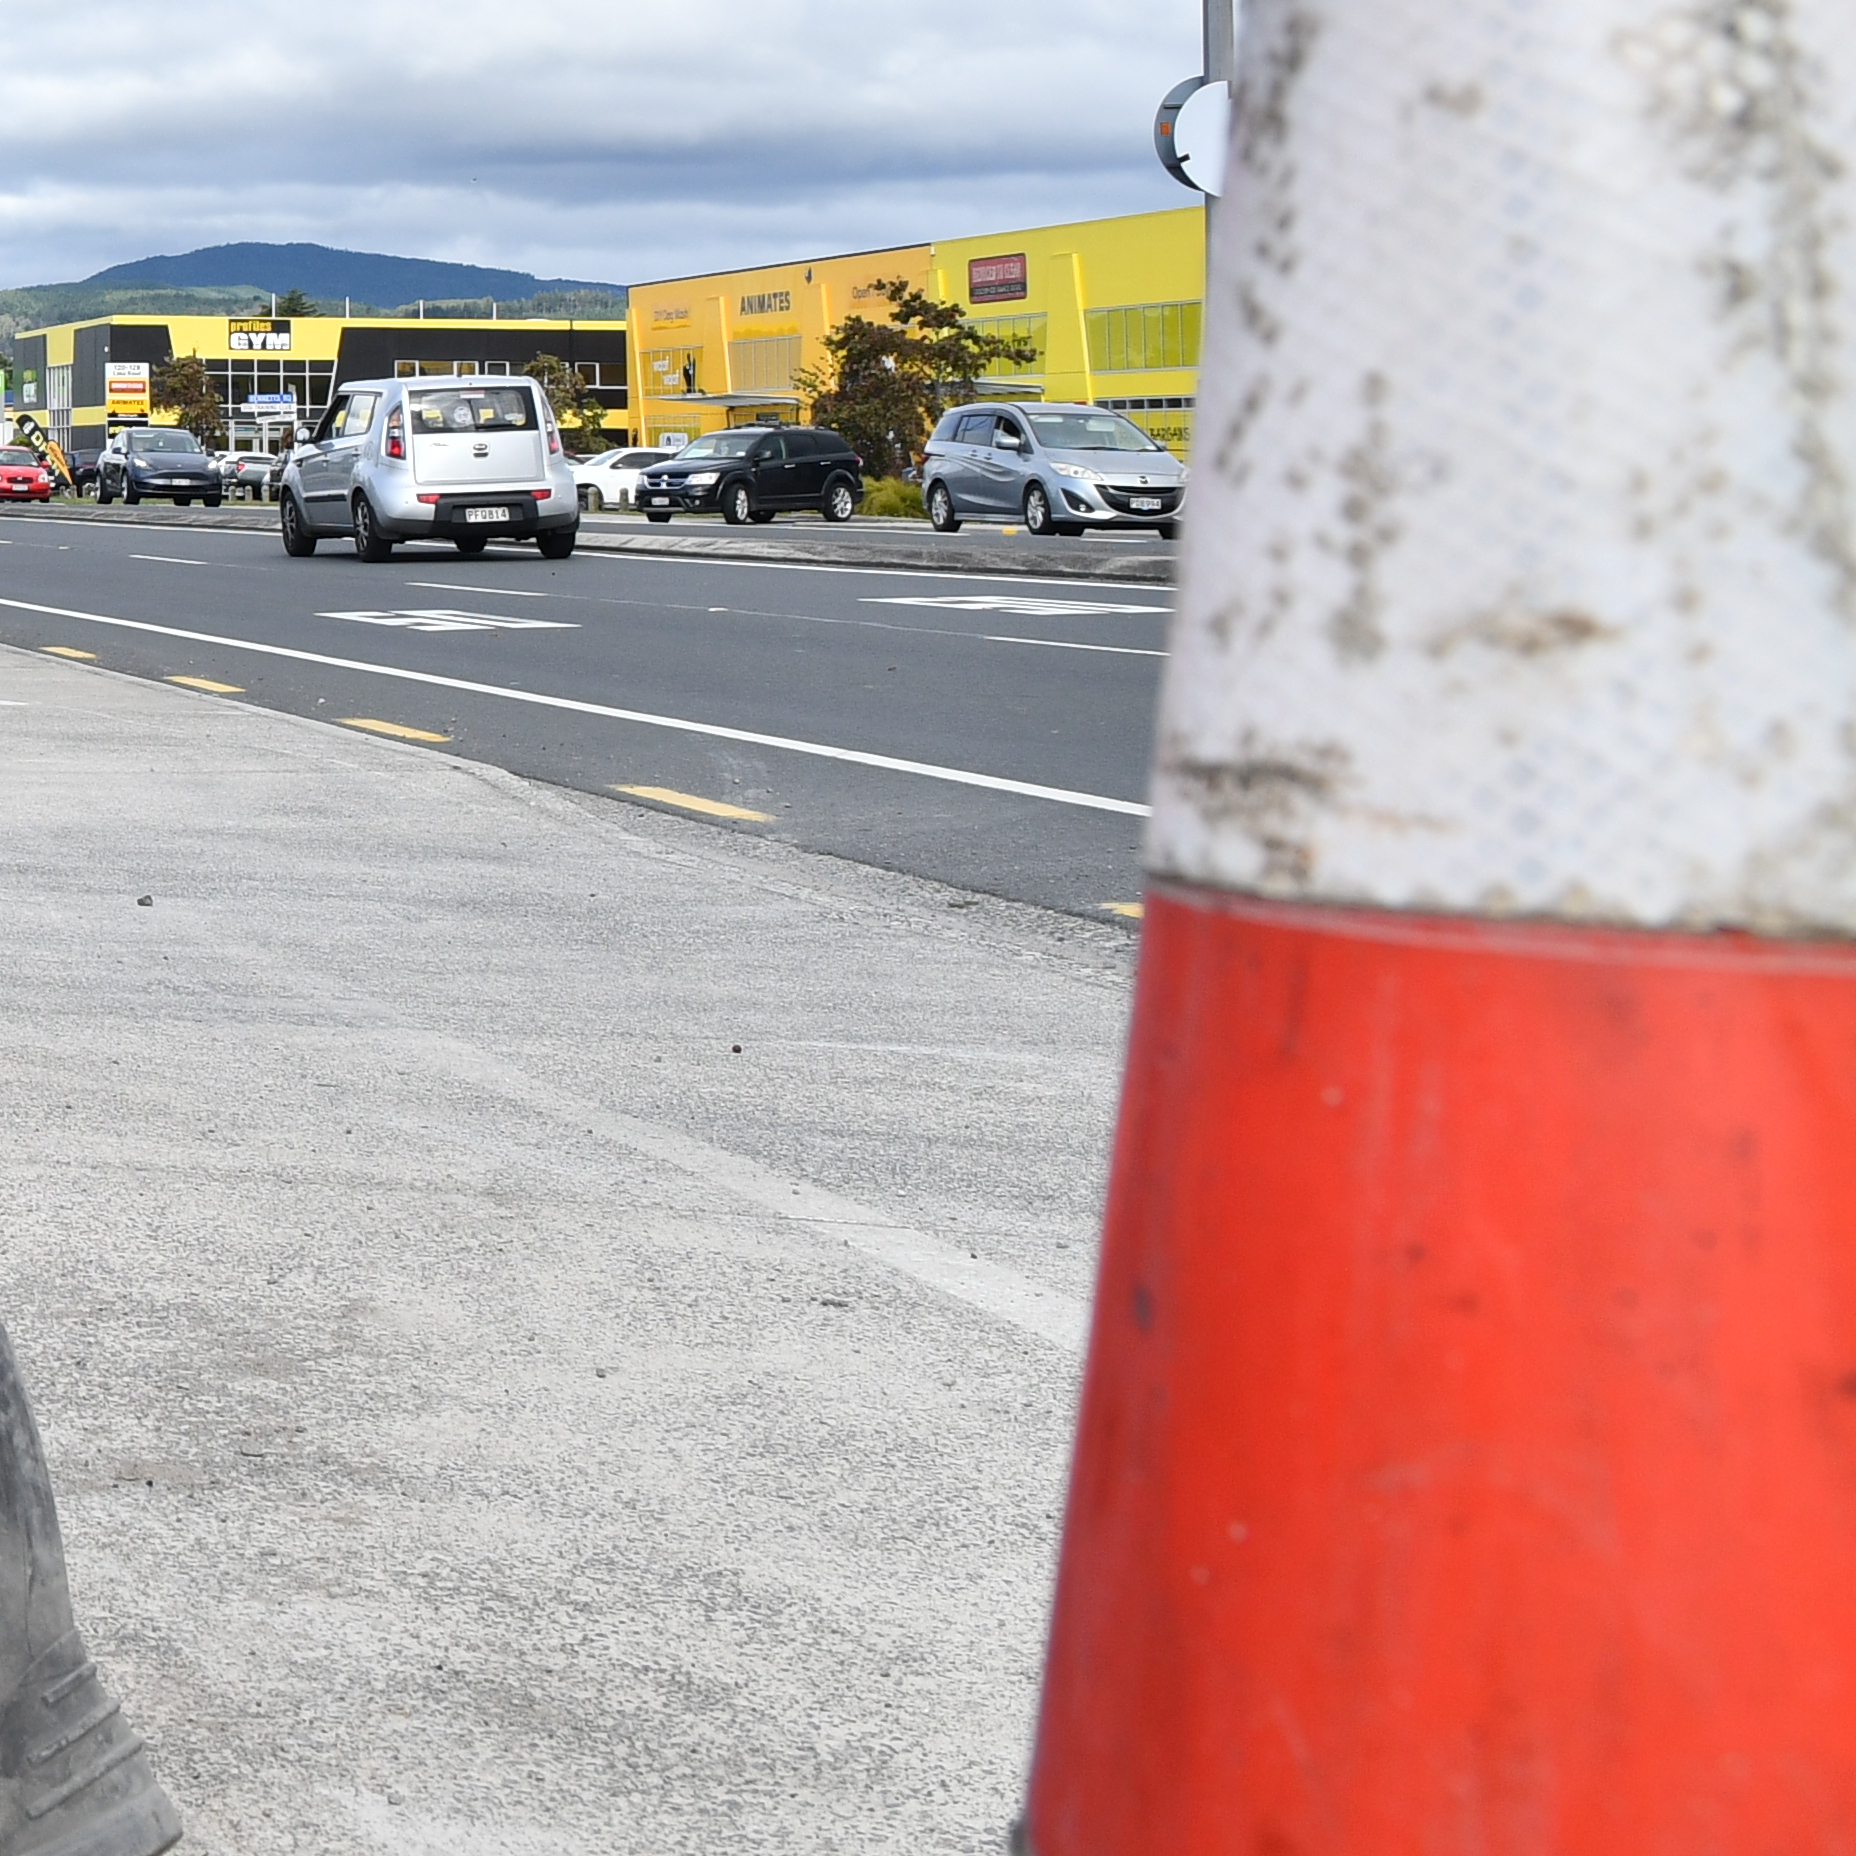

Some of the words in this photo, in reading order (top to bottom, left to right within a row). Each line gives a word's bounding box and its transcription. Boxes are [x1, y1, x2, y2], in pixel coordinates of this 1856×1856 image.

[740, 290, 791, 316] ANIMATES
[230, 320, 273, 333] profiles
[230, 332, 290, 350] GYM
